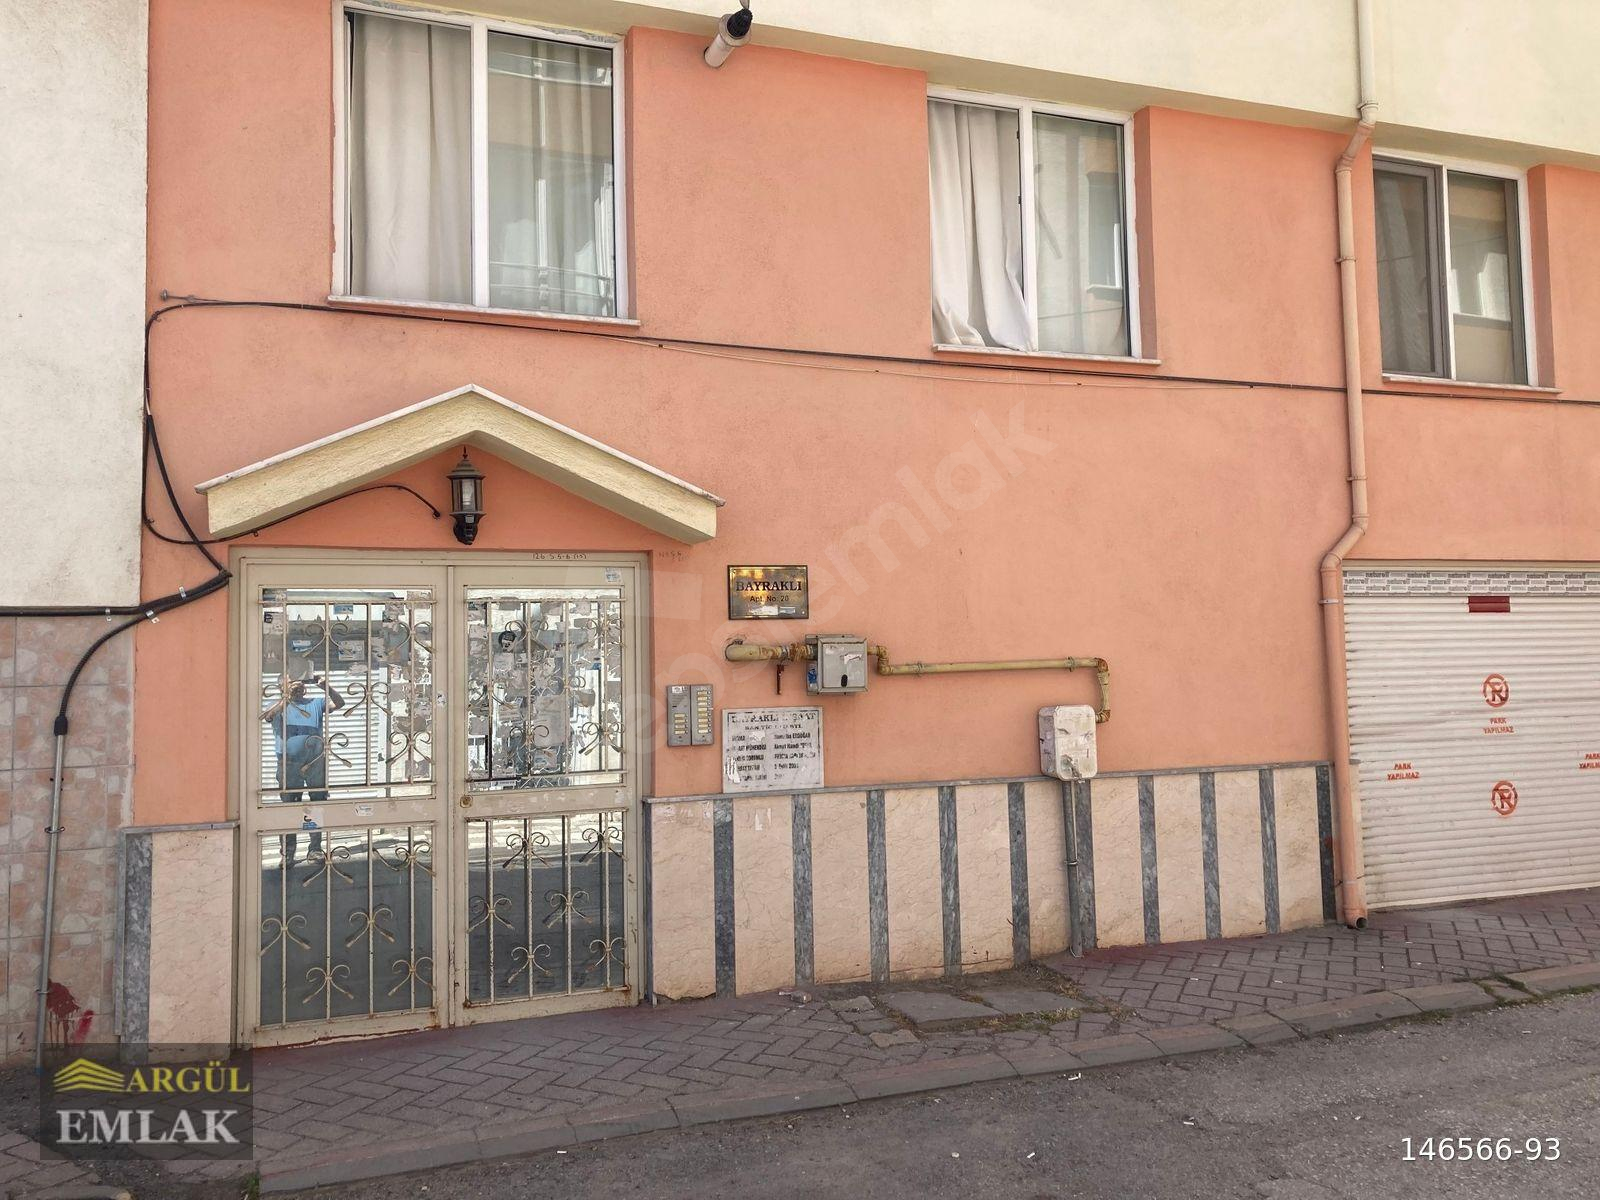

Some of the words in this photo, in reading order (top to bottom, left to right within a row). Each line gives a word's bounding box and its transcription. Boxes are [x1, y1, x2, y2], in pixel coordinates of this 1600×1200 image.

[736, 580, 802, 592] BAYRAKLI
[1483, 725, 1514, 734] YAPILMAZ
[1393, 762, 1412, 770] PARK
[1387, 772, 1420, 781] YAPILMAZ
